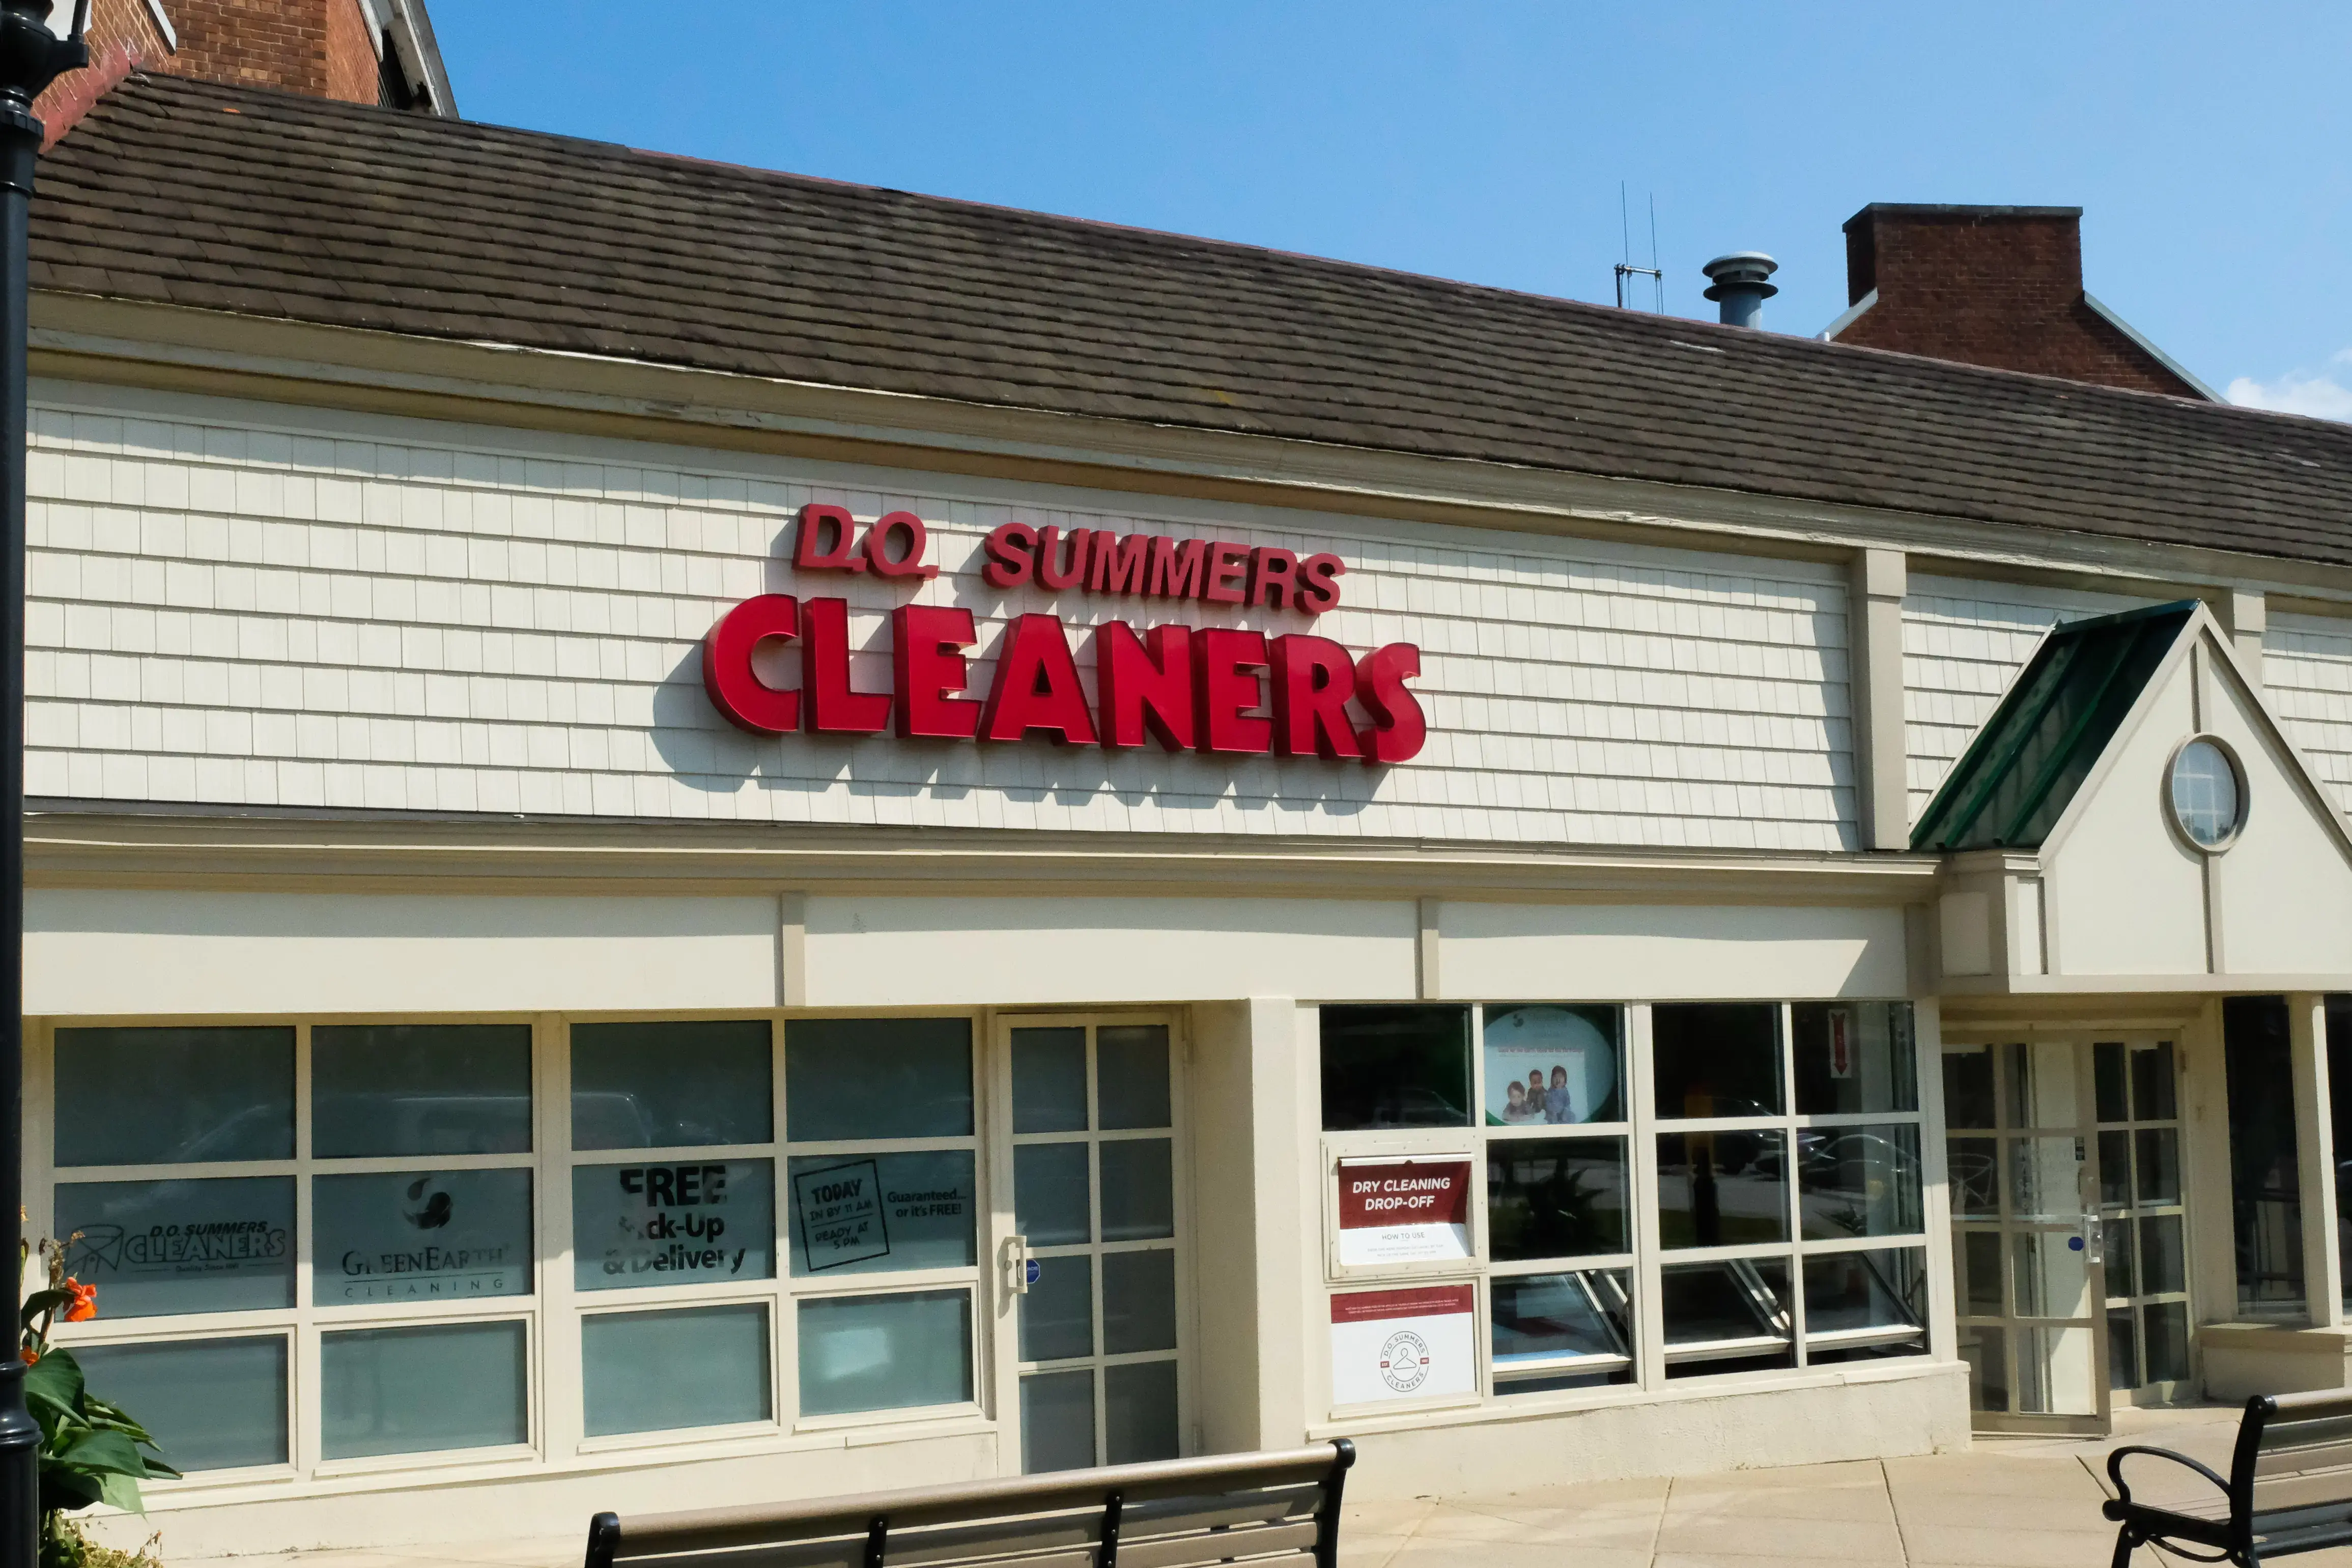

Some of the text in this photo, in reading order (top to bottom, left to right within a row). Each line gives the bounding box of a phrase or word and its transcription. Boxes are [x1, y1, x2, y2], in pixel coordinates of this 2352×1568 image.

[982, 522, 1346, 613] SUMMERS
[703, 593, 1426, 764] CLEANERS
[620, 1165, 727, 1207] FREE
[812, 1178, 862, 1205] TODAY
[1353, 1177, 1450, 1193] DRY CLEANING
[887, 1188, 967, 1203] Guaranteed...
[1365, 1195, 1435, 1211] DROP-OFF
[809, 1209, 824, 1221] IN
[827, 1205, 841, 1218] BY
[856, 1199, 873, 1211] AM
[896, 1203, 961, 1217] or it's FREE!
[150, 1221, 268, 1237] D.O. SUMMERS
[815, 1221, 869, 1242] READY AT
[125, 1229, 286, 1263] CLEANERS
[834, 1236, 860, 1250] 5 PM
[345, 1279, 503, 1298] CLEANING
[1395, 1334, 1425, 1354] SUMMERS
[1386, 1372, 1424, 1389] CLEANERS
